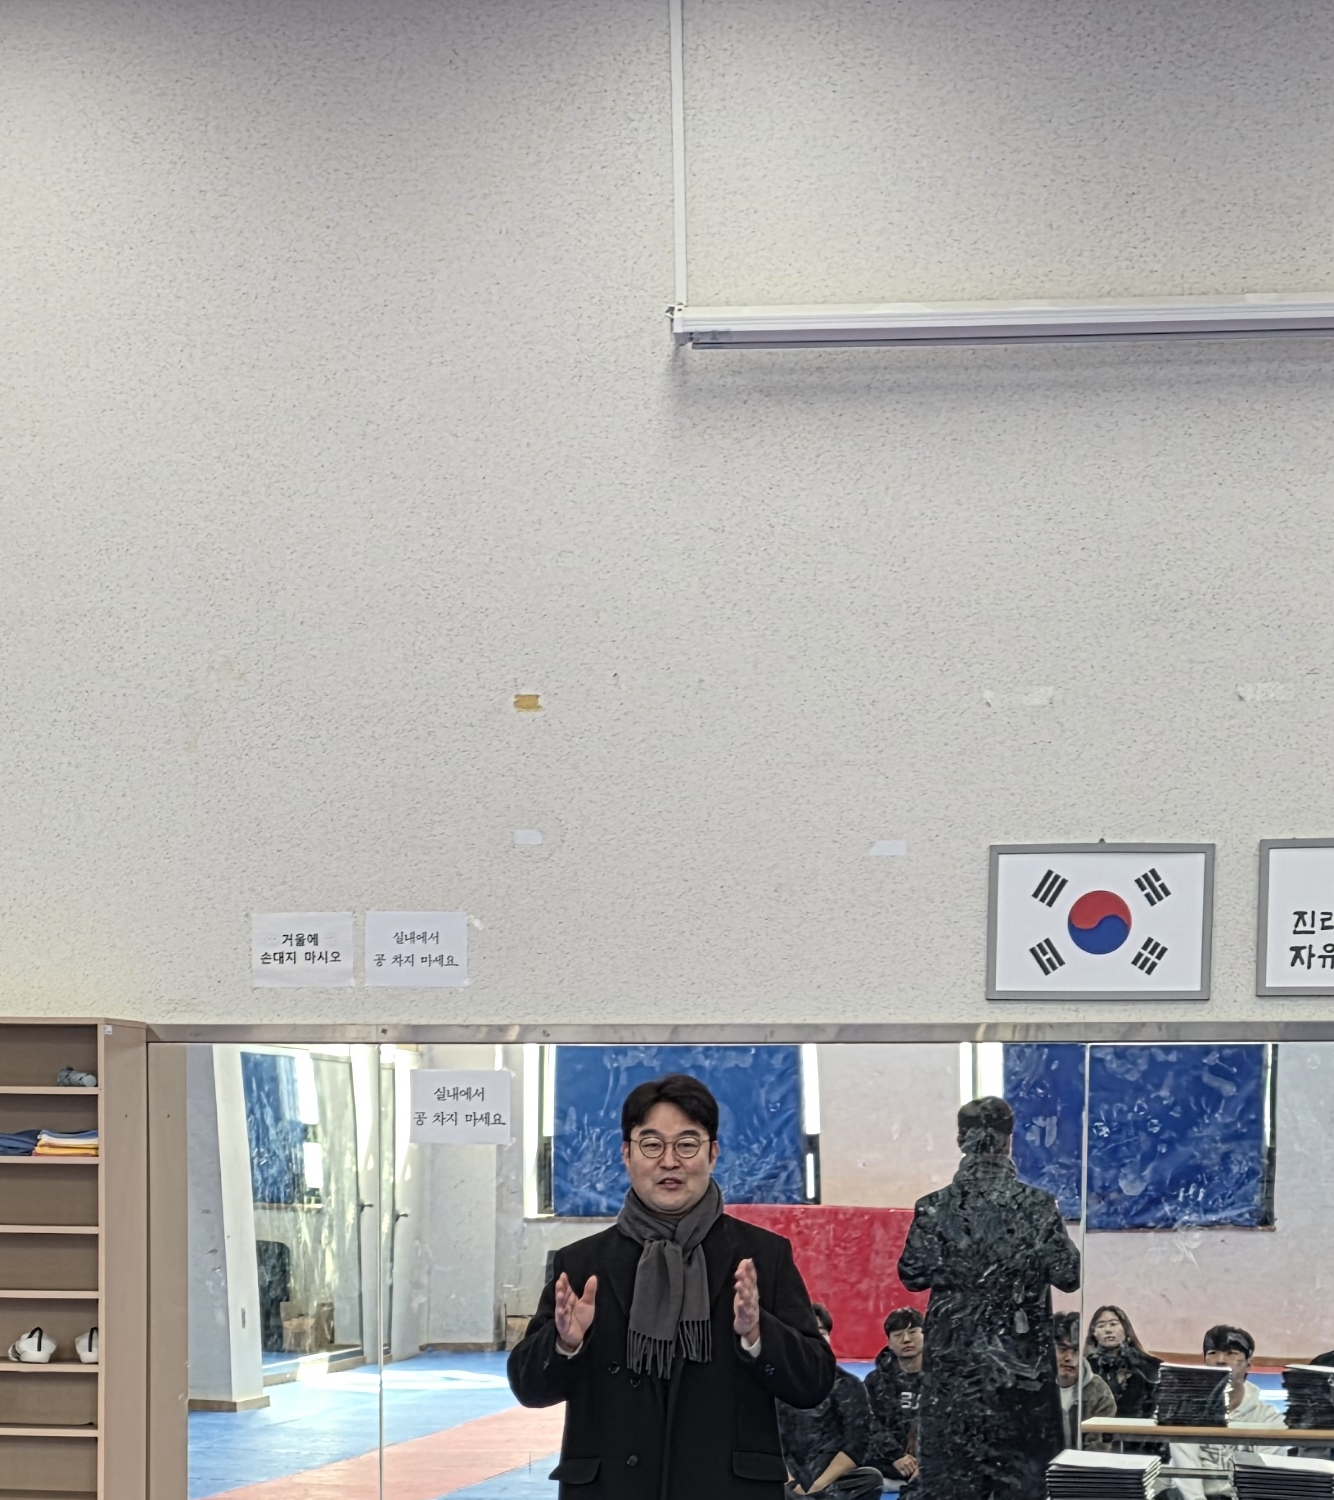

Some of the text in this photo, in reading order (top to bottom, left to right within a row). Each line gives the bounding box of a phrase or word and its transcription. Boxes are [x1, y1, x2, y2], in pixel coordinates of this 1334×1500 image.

[282, 932, 319, 947] 거울에
[391, 930, 440, 946] 실내에서
[260, 950, 343, 965] 손대지 마시오
[372, 952, 461, 968] 공 차지 마세요
[433, 1086, 485, 1102] 실내에서
[413, 1111, 507, 1127] 공 차지 마세요
